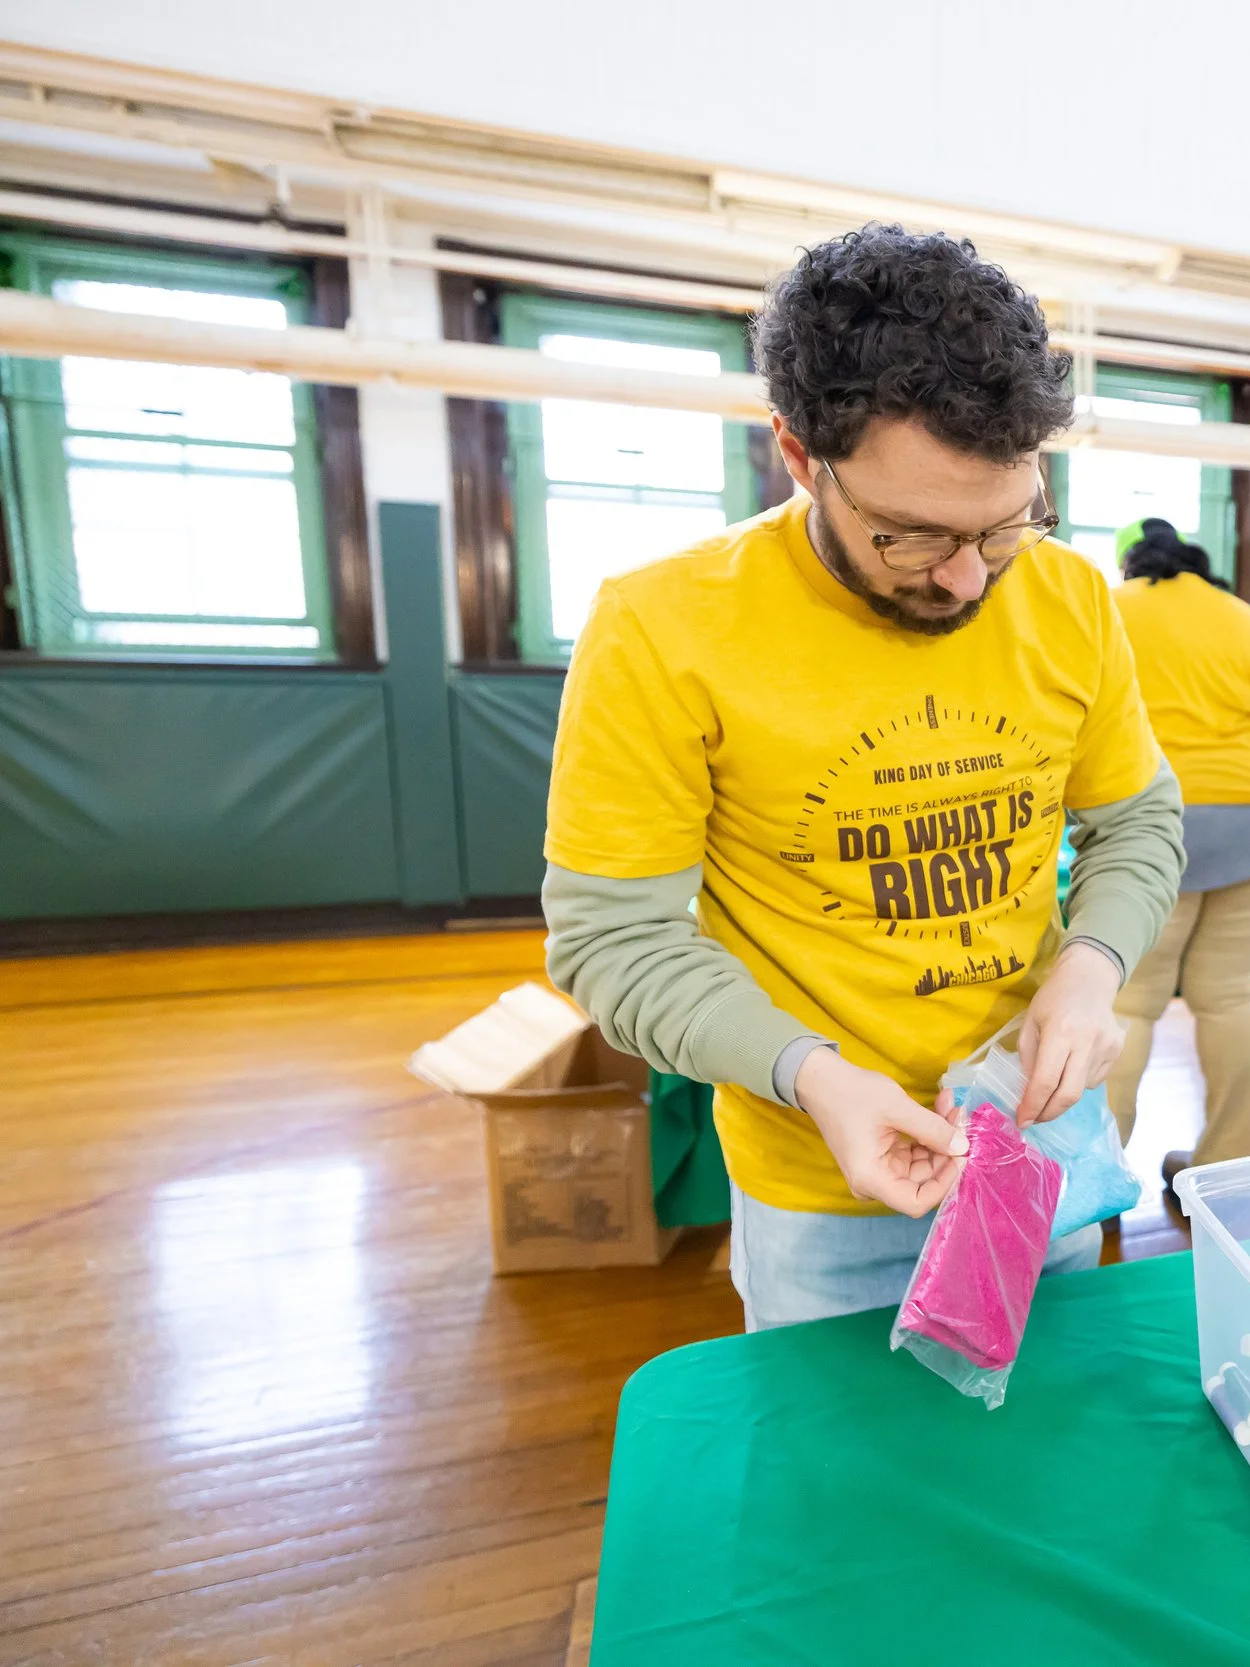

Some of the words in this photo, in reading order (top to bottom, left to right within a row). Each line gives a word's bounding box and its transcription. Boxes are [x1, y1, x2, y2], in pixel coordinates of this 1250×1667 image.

[874, 766, 905, 785] KING
[910, 763, 933, 781] DAY
[937, 760, 951, 777] OF
[954, 753, 1004, 774] SERVICE
[834, 808, 865, 822] THE
[868, 804, 902, 819] TIME
[906, 802, 919, 813] IS
[922, 791, 979, 810] ALWAYS
[981, 783, 1016, 798] RIGHT
[1019, 776, 1033, 788] TO
[837, 823, 891, 862] DO
[903, 799, 998, 854] WHAT
[1009, 790, 1035, 834] IS
[780, 851, 813, 862] UNITY
[868, 837, 1015, 920] RIGHT
[950, 965, 998, 986] CHICAGO
